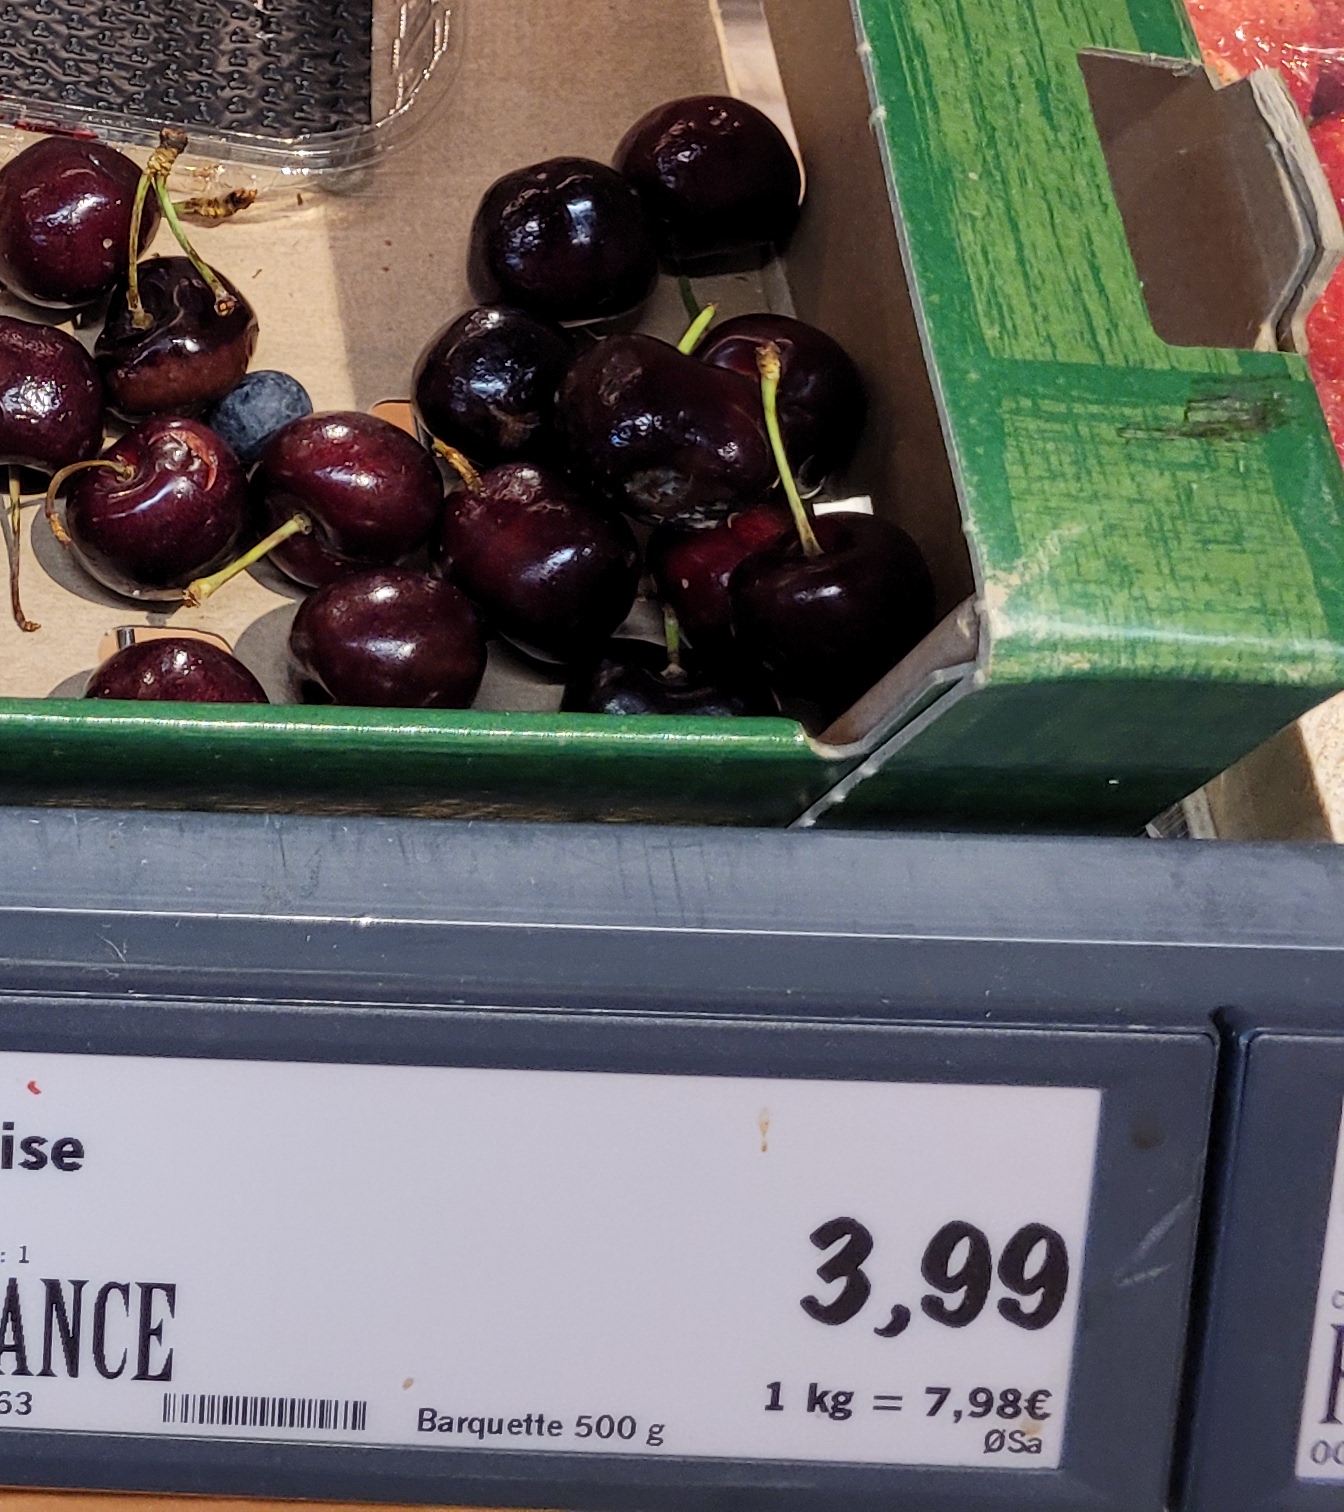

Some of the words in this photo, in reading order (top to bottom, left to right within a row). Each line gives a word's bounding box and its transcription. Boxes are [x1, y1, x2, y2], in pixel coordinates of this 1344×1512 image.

[18, 1244, 31, 1265] 1
[798, 1215, 1071, 1338] 3,99
[764, 1381, 786, 1413] 1
[806, 1383, 855, 1421] kg
[872, 1392, 904, 1414] =
[923, 1386, 1053, 1425] 7,98€
[416, 1406, 564, 1442] Barquette
[574, 1413, 637, 1441] 500
[647, 1420, 665, 1448] g
